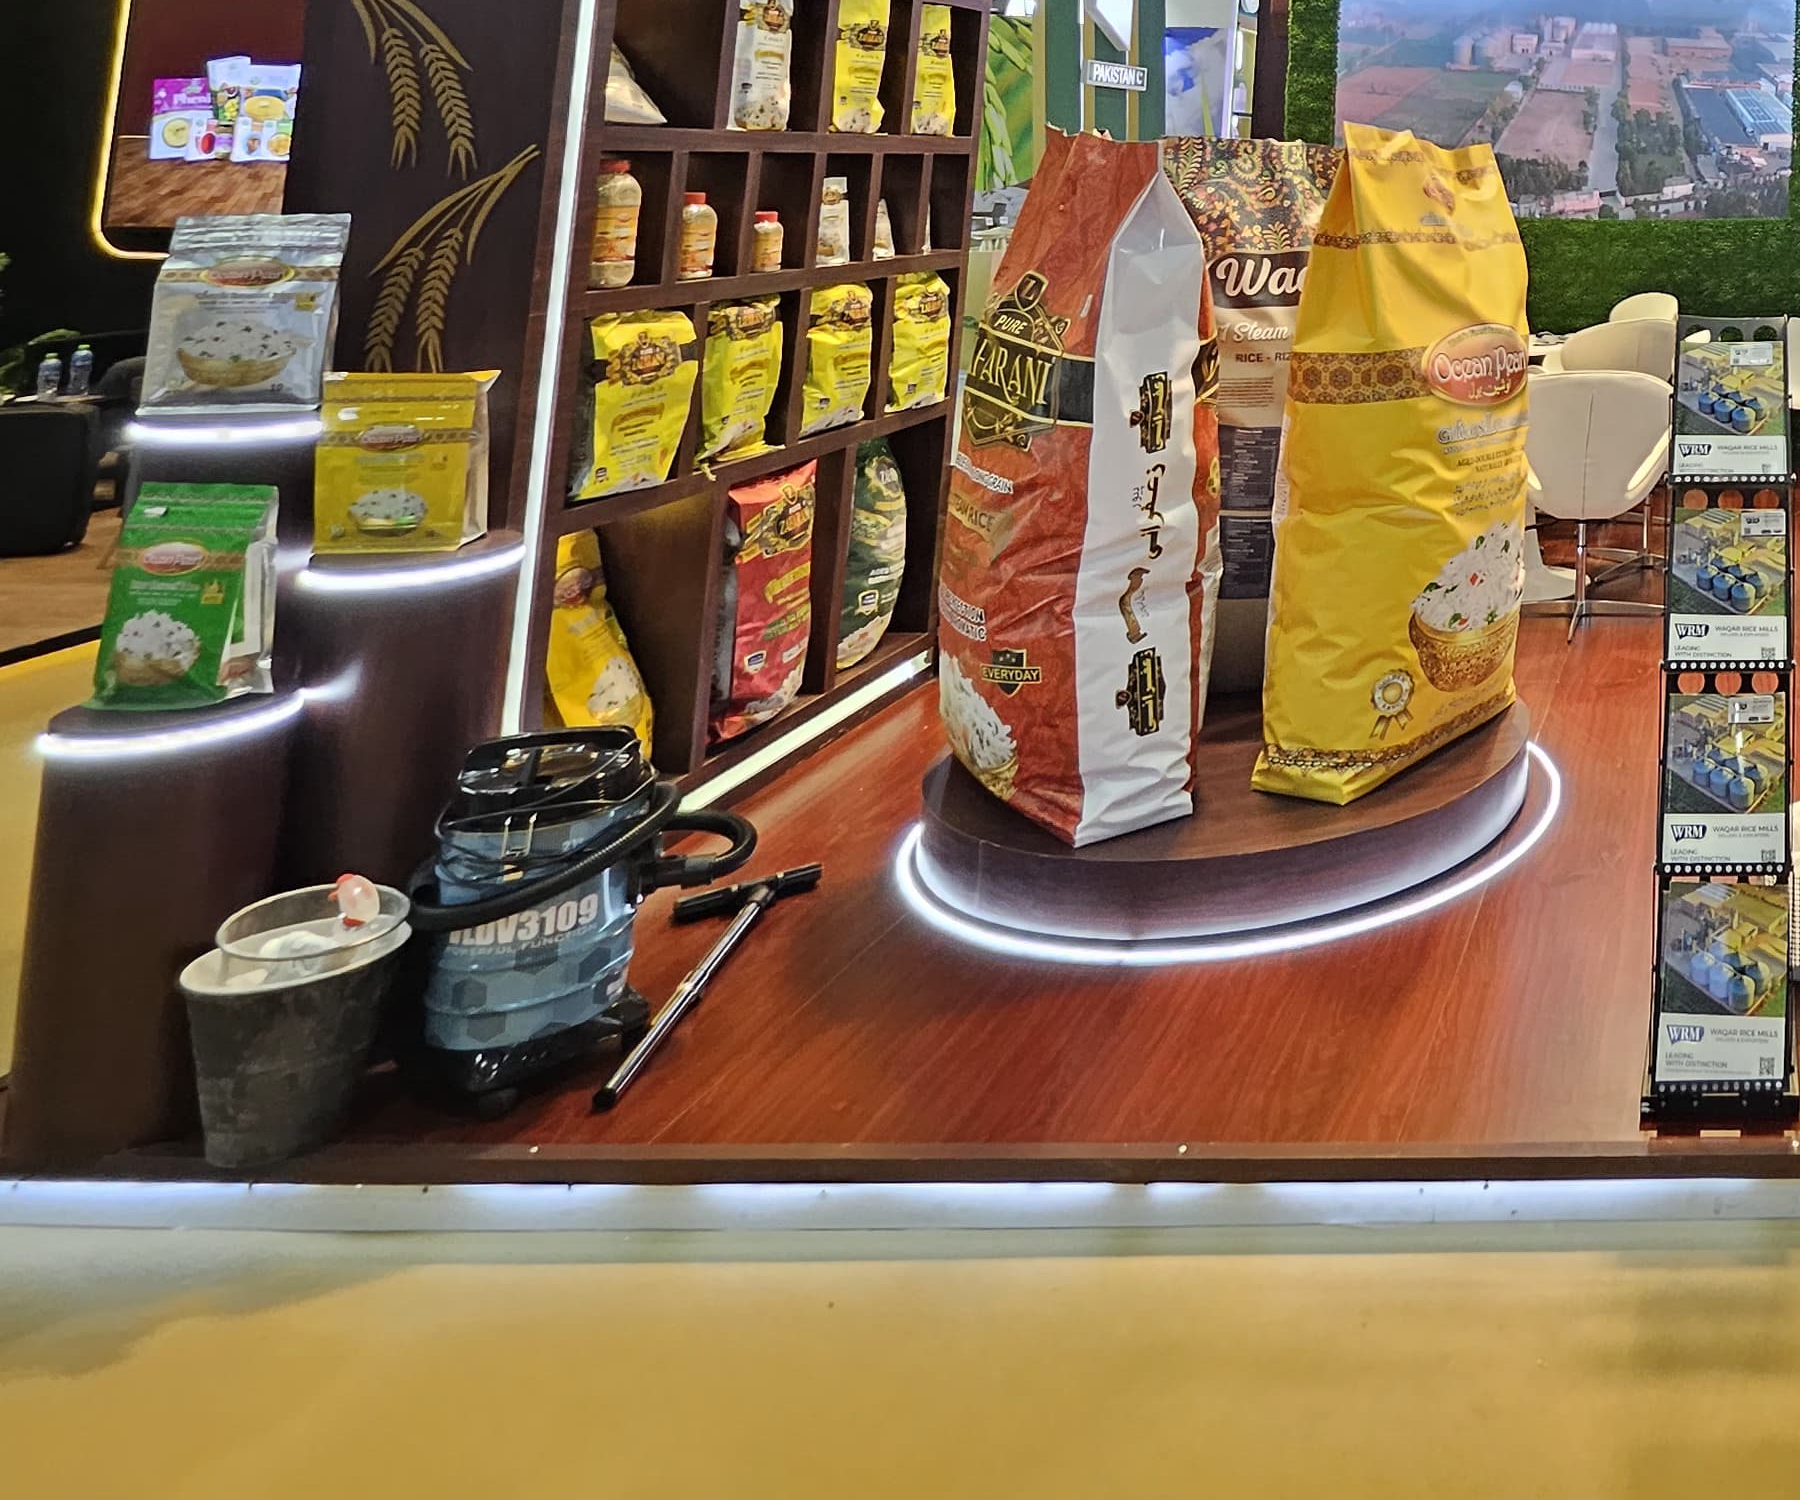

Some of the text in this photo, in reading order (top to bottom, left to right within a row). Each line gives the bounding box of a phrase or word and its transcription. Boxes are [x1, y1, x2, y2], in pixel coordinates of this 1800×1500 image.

[1093, 63, 1135, 85] PAKISTAN
[994, 314, 1028, 335] PURE
[1233, 321, 1289, 342] Steam
[1235, 352, 1263, 363] RICE
[1434, 346, 1525, 383] Ocean Pear
[972, 338, 1053, 406] FARANI
[1680, 445, 1709, 457] WRM
[1677, 624, 1706, 637] WRM
[982, 667, 1041, 683] EVERYDAY
[1672, 825, 1704, 839] WRM
[1668, 1026, 1778, 1041] WRM WAQAR RICE MILLS
